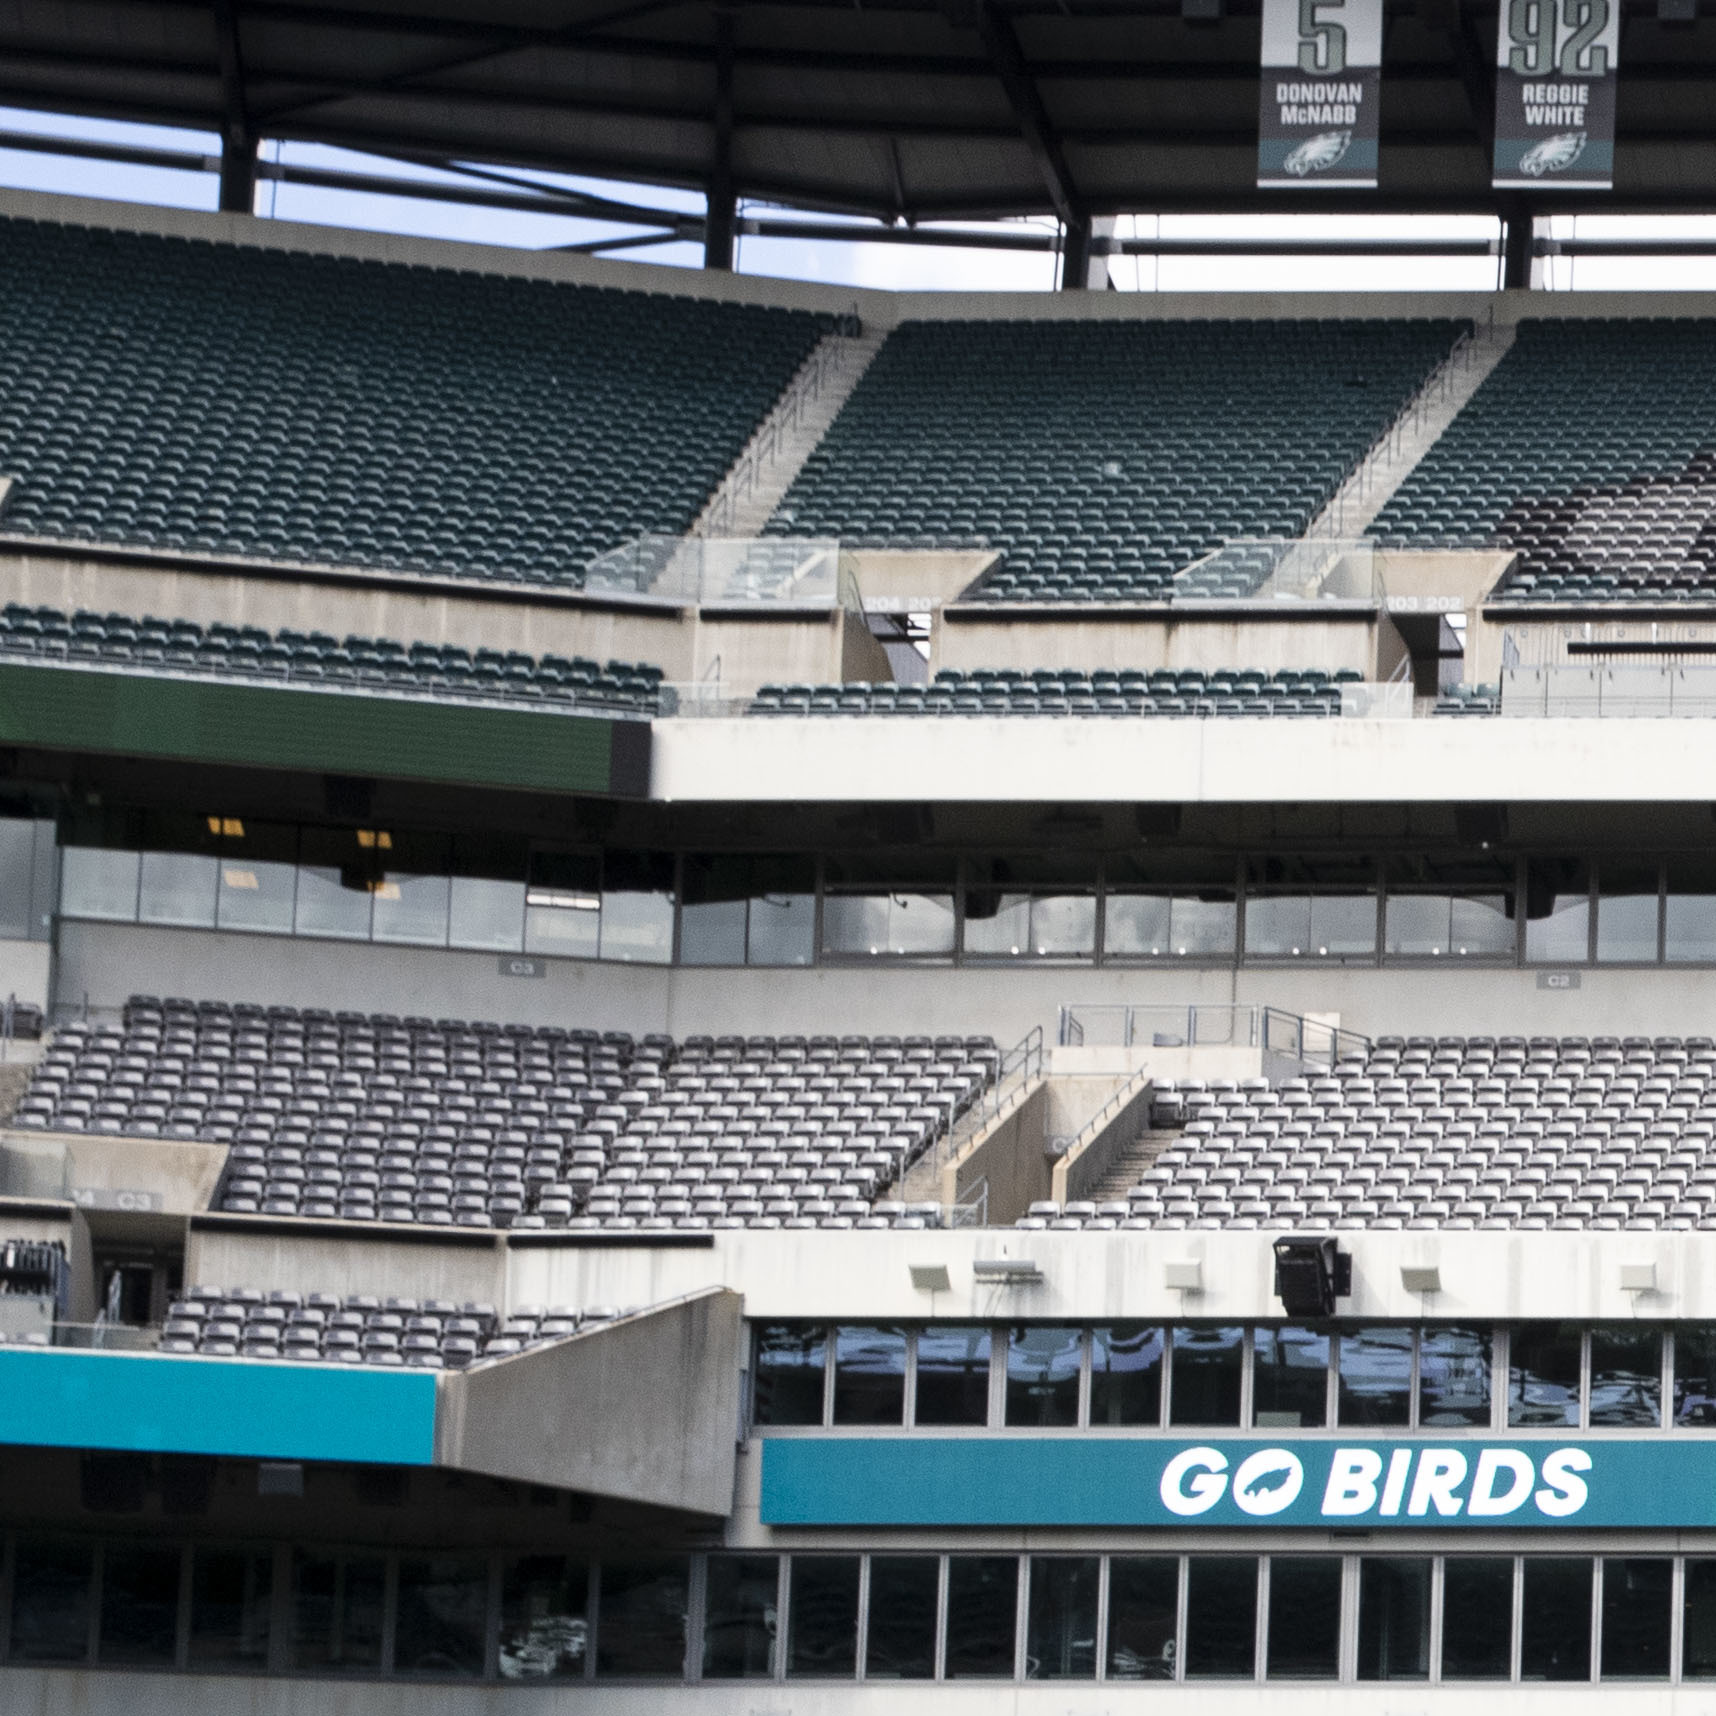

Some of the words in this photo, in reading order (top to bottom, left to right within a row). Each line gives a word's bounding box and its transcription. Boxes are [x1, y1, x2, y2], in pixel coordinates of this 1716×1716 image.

[1298, 0, 1347, 76] 5
[1509, 0, 1608, 77] 92
[1276, 83, 1363, 104] DONOVAN
[1522, 84, 1589, 105] REGGIE
[1281, 105, 1356, 126] McNABB
[1524, 106, 1585, 126] WHITE
[1160, 1446, 1305, 1516] GO
[1320, 1447, 1593, 1517] BIRDS
